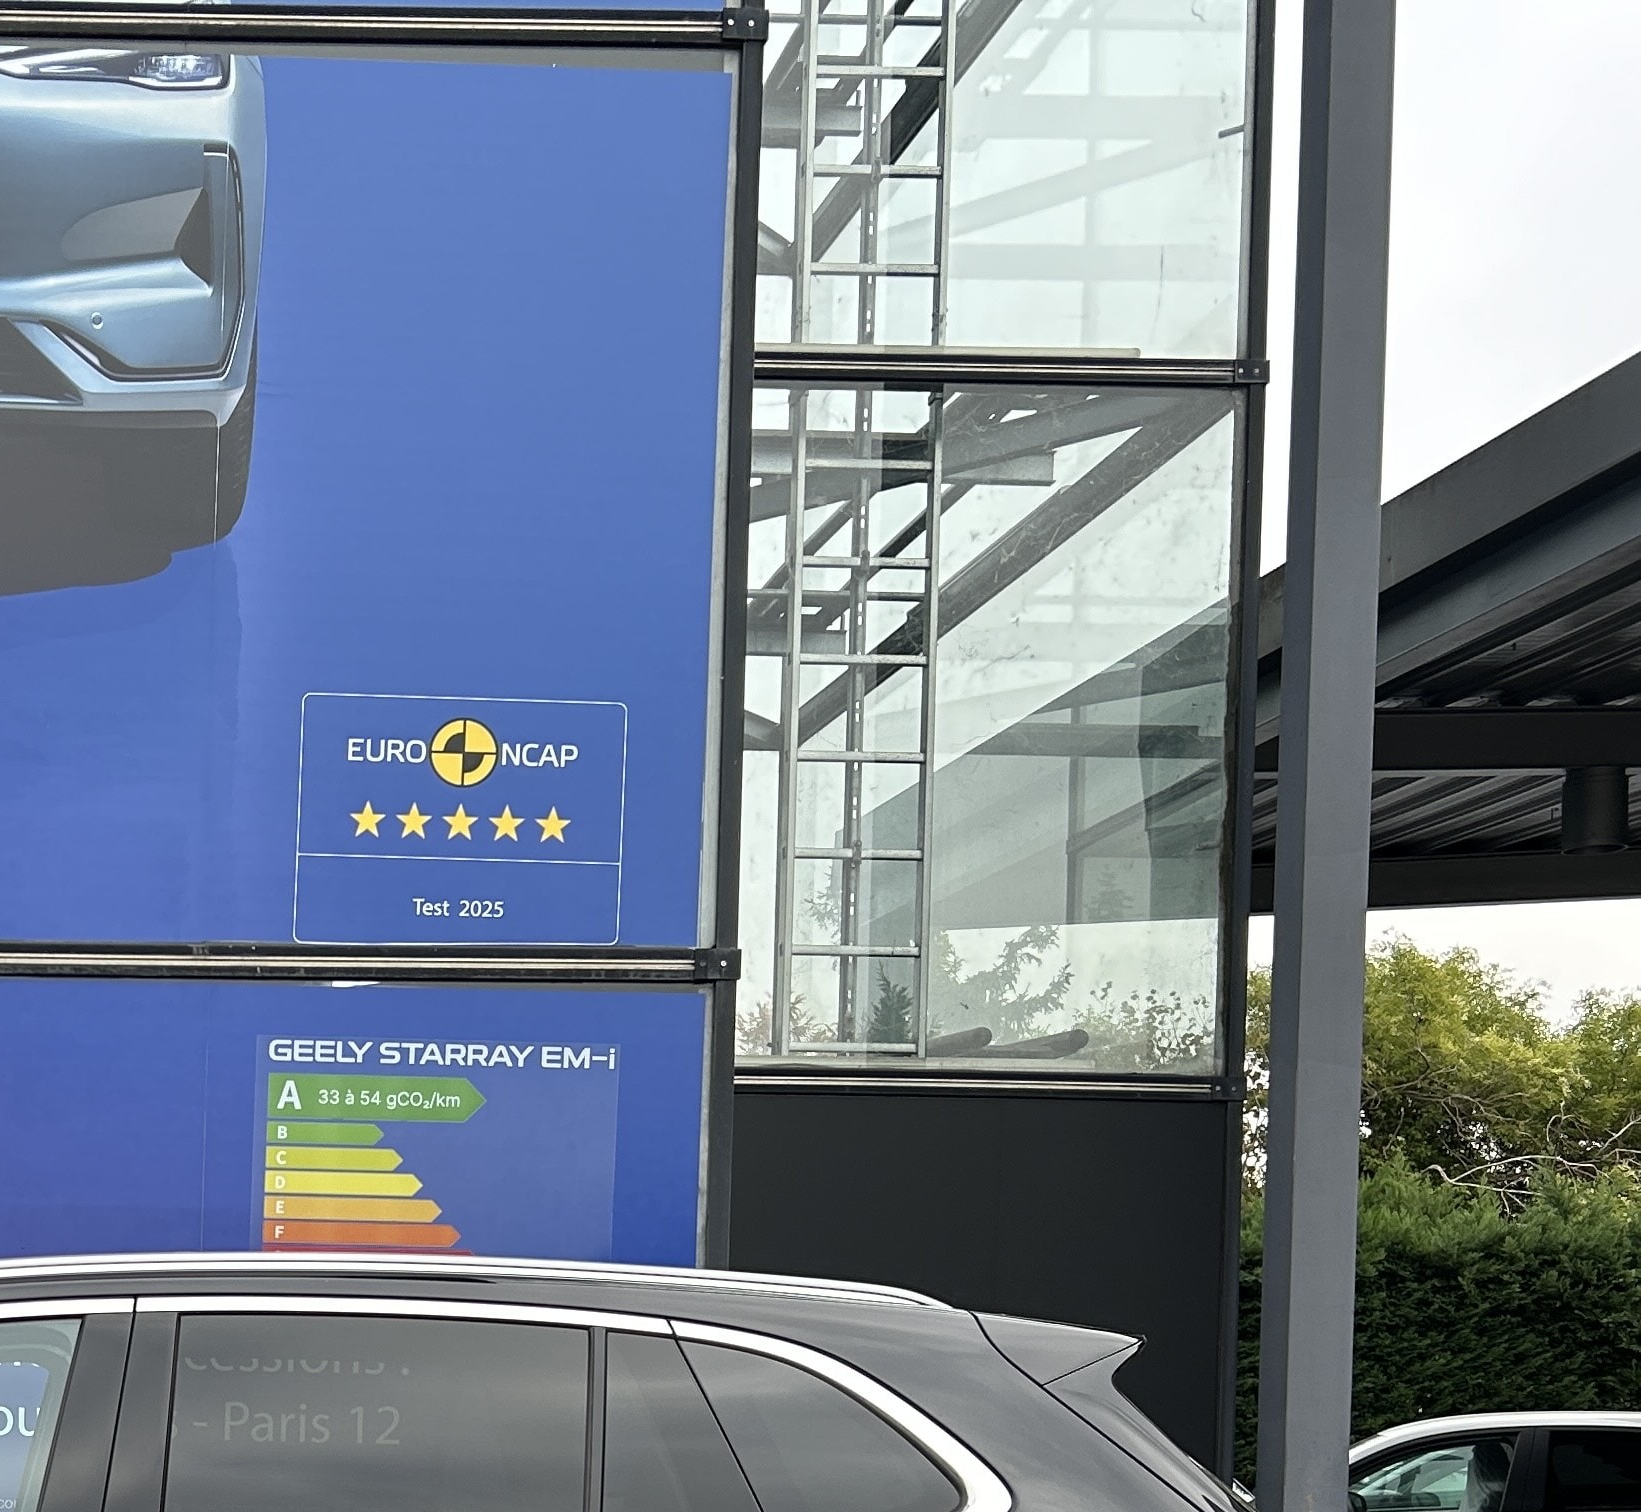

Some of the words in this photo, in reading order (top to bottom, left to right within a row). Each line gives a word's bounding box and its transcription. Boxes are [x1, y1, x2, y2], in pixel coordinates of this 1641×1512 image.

[347, 738, 427, 763] EURO
[501, 743, 578, 768] NCAP
[413, 898, 449, 917] Test
[459, 900, 504, 918] 2025
[269, 1039, 373, 1063] GEELY
[379, 1042, 534, 1067] STARRAY
[540, 1046, 616, 1070] EM-i
[277, 1080, 302, 1110] A
[318, 1089, 340, 1105] 33
[345, 1089, 355, 1105] à
[360, 1090, 381, 1106] 54
[277, 1125, 288, 1139] B
[276, 1151, 287, 1165] C
[275, 1176, 286, 1189] D
[275, 1200, 285, 1214] E
[274, 1225, 284, 1239] F
[223, 1401, 331, 1443] Paris
[350, 1405, 401, 1445] 12
